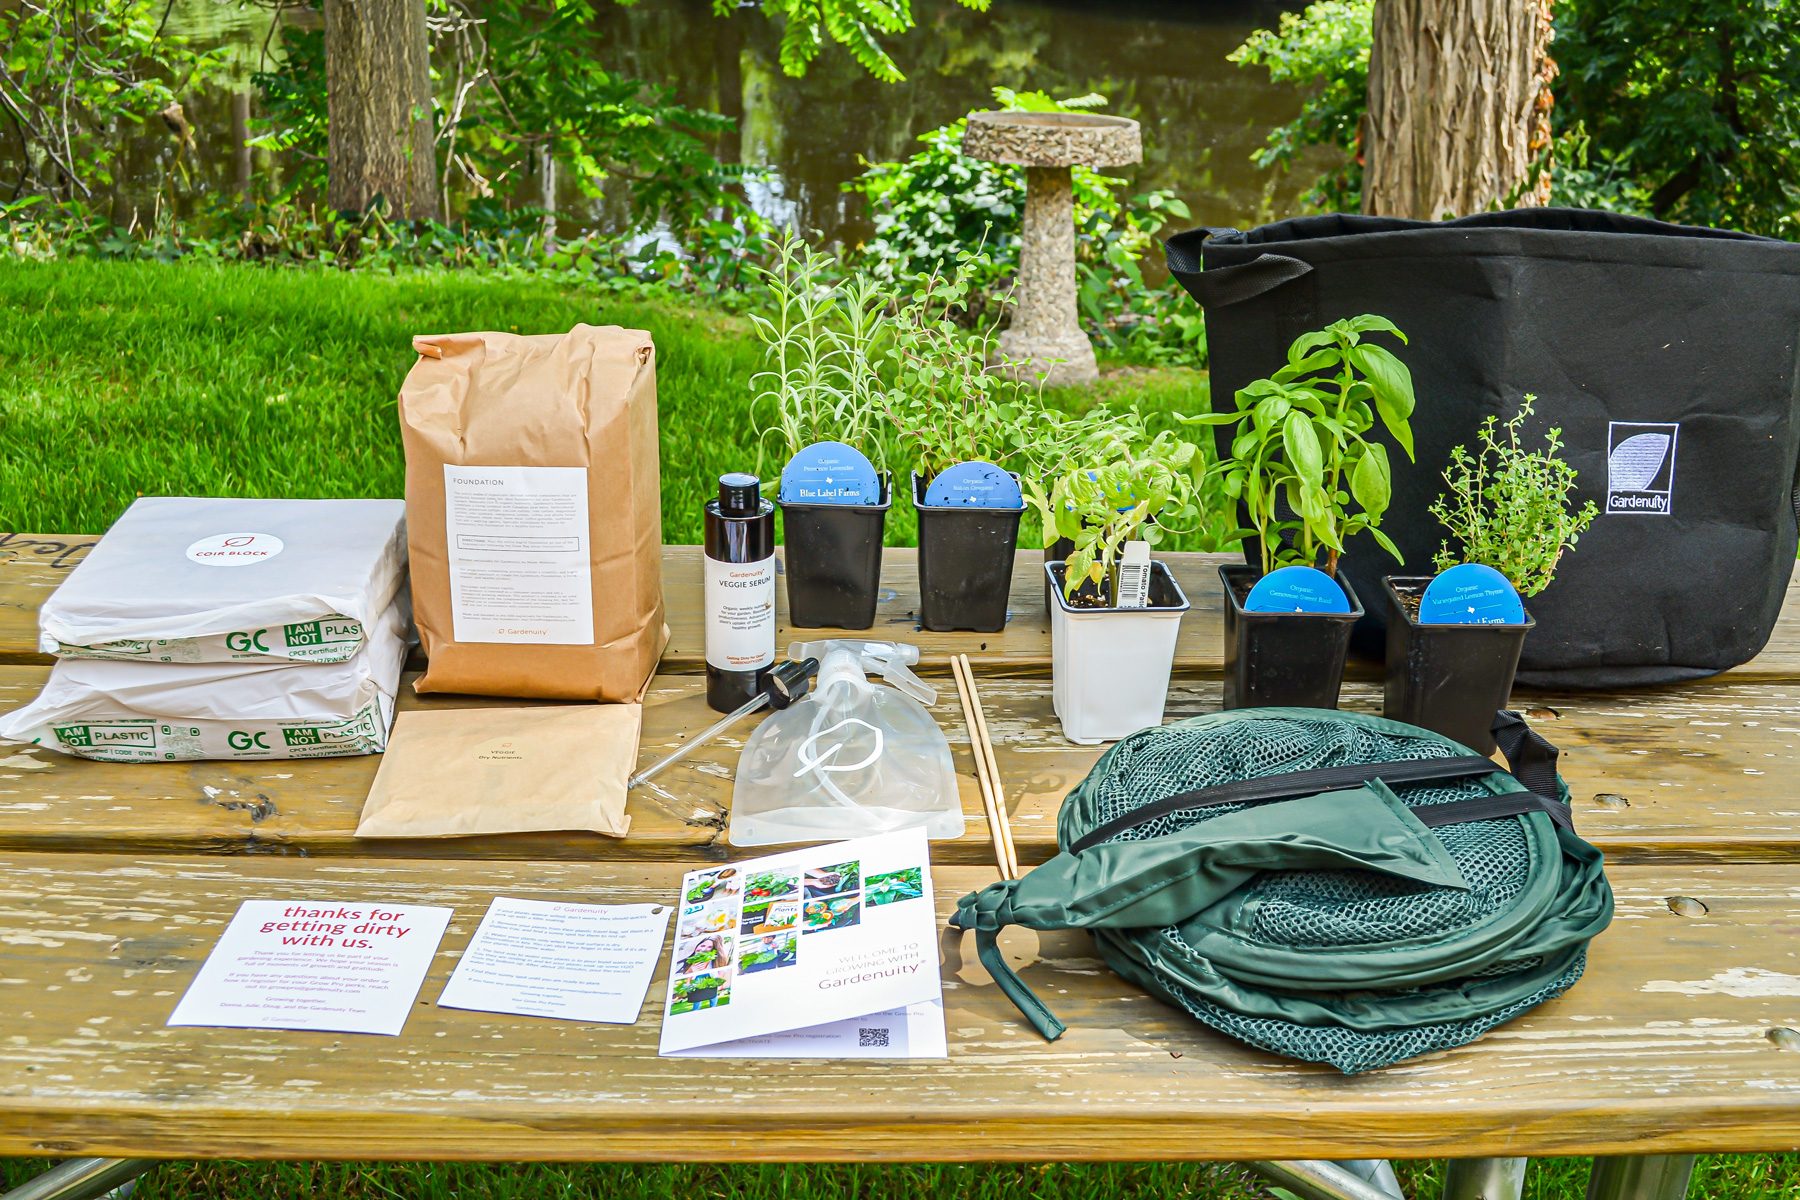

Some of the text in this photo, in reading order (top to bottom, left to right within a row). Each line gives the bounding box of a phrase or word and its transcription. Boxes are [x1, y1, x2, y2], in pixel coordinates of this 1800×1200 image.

[453, 478, 504, 486] FOUNDATION
[800, 487, 860, 498] Blue Label Farms
[1610, 494, 1668, 512] Gardenuity
[729, 568, 764, 578] Gardenuity
[1140, 564, 1149, 590] Tomato
[718, 576, 771, 589] VEGGIE SERUM
[1290, 584, 1313, 594] Organic
[1455, 584, 1478, 593] Organic
[1432, 588, 1504, 605] Variegated Lemon Thyme
[287, 623, 316, 635] I AM
[507, 628, 548, 636] Gardenuity
[226, 629, 270, 652] GC
[289, 633, 319, 646] NOT
[64, 727, 85, 737] AM
[94, 731, 149, 741] PLASTIC
[294, 728, 313, 736] AM
[323, 722, 371, 740] PLASTIC
[66, 737, 88, 746] OT
[228, 730, 271, 750] GC
[289, 736, 316, 745] NOT
[284, 906, 405, 922] thanks for
[563, 906, 609, 915] Gardenuity
[260, 920, 411, 939] getting dirty
[282, 933, 374, 950] with us.
[838, 942, 919, 964] WELCOME TO
[826, 951, 919, 976] GROWING WITH
[818, 963, 920, 990] Gardenuity
